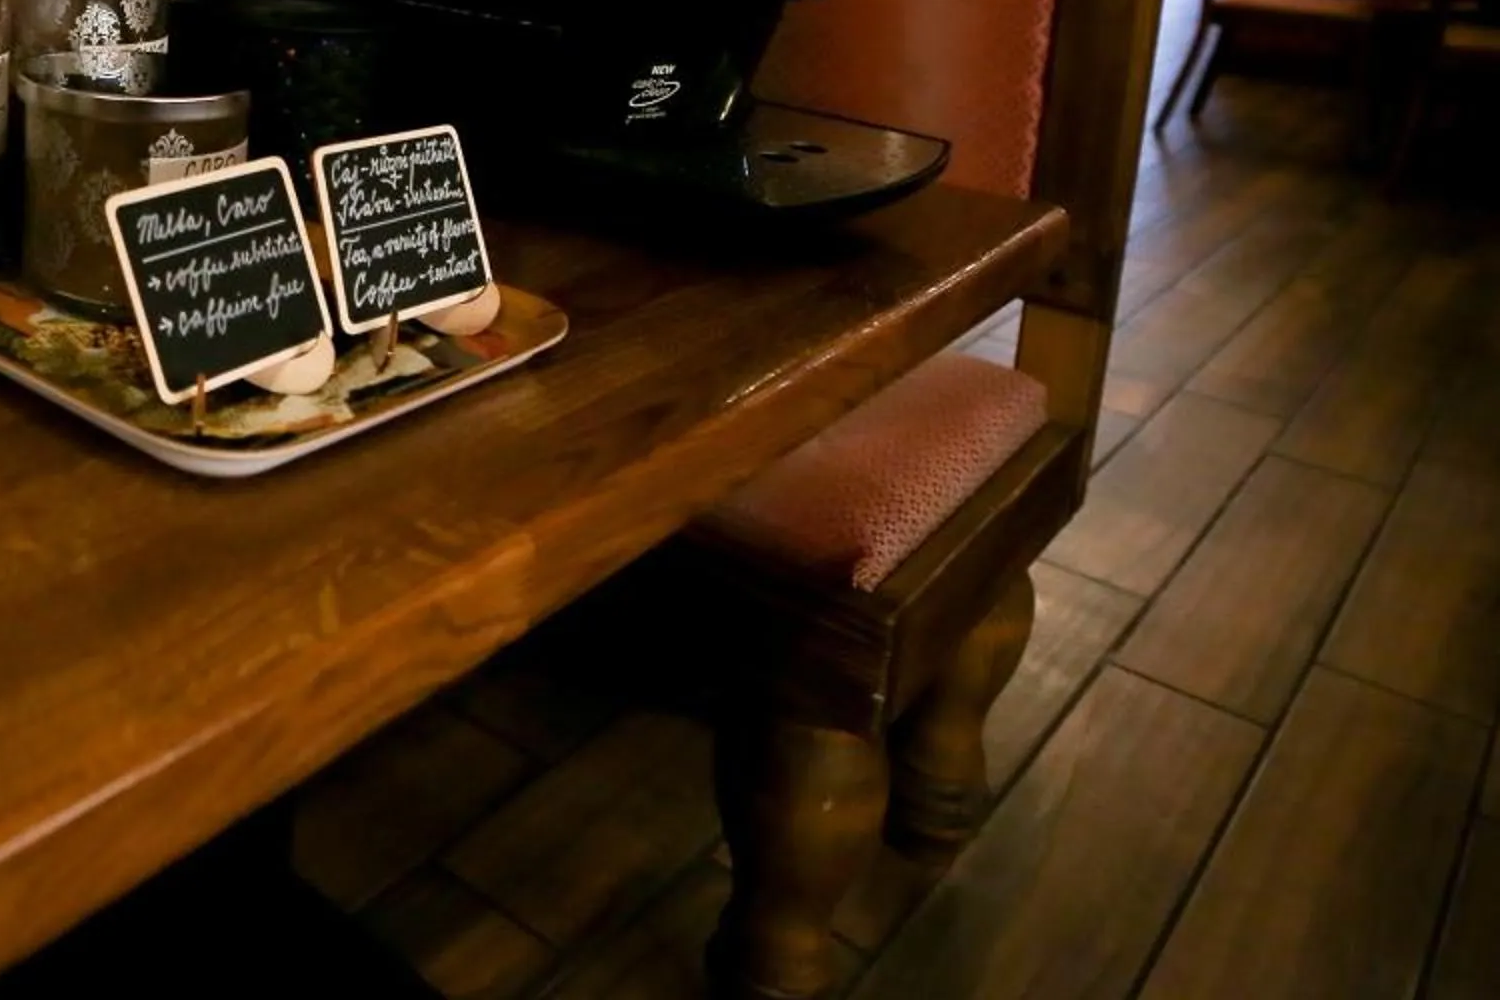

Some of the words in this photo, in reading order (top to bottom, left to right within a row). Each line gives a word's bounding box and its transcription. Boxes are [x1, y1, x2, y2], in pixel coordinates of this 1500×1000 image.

[217, 187, 276, 227] Caro
[265, 271, 305, 320] free
[353, 271, 419, 309] Coffee
